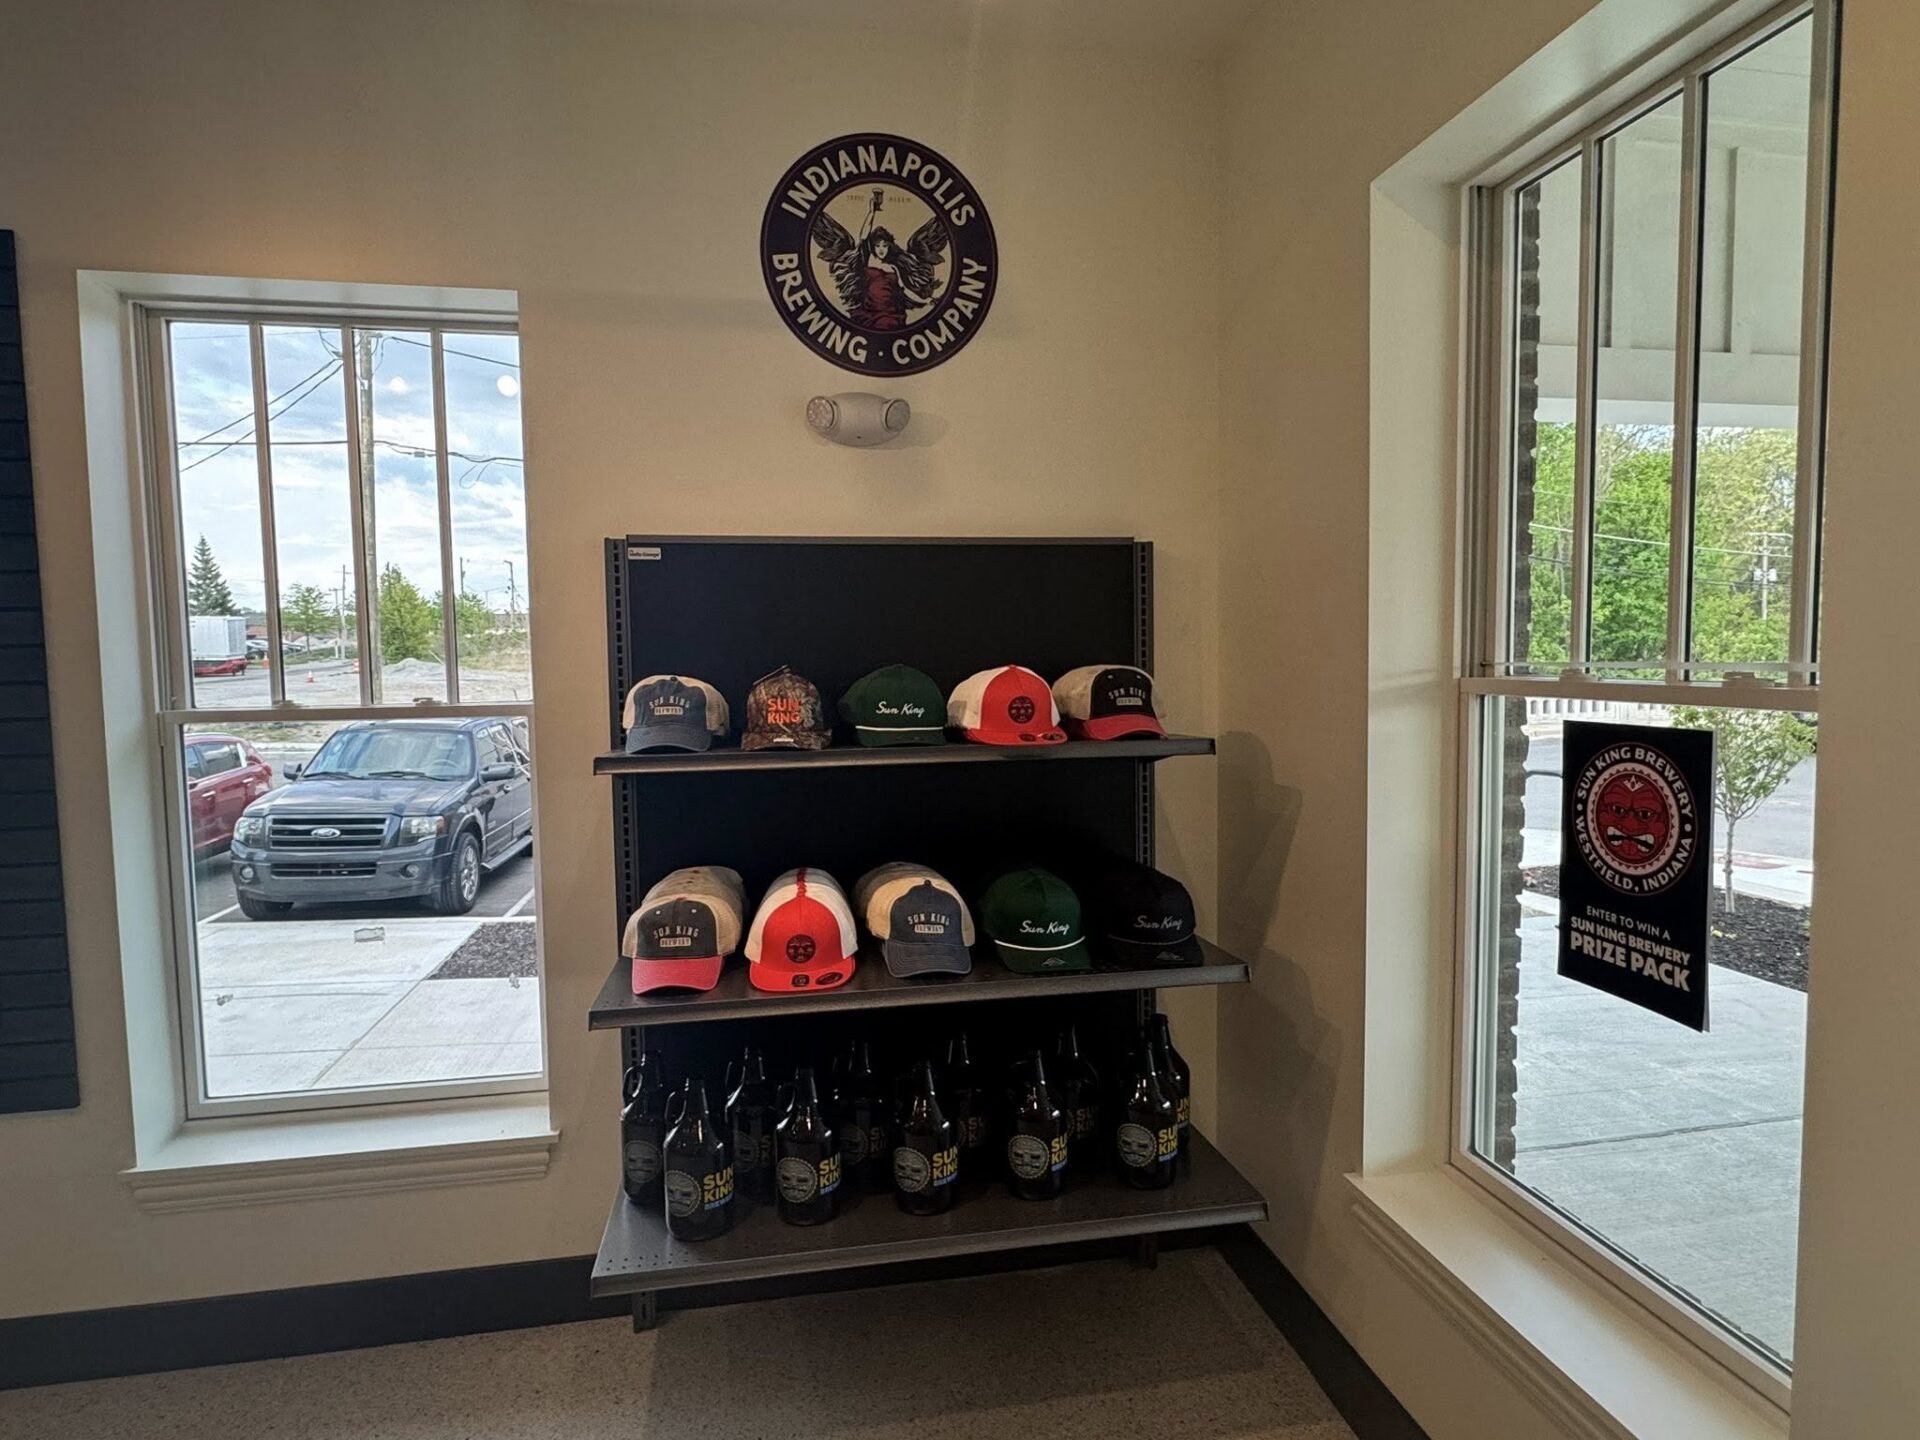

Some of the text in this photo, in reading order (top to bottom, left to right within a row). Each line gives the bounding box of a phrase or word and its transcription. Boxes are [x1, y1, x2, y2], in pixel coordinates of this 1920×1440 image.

[781, 144, 976, 227] INDIANAPOLIS
[772, 253, 988, 365] BREWING COMPANY
[767, 698, 800, 711] SUN
[875, 700, 925, 718] Sun King
[767, 711, 801, 725] KING
[1577, 747, 1694, 818] SUN KING BREWERY
[1576, 815, 1693, 893] WESTFIELD, INDIANA
[1019, 919, 1070, 936] Sun King
[1134, 914, 1183, 931] Sun King
[1586, 905, 1671, 941] ENTER TO WIN A
[1570, 915, 1691, 966] SUN KING BREWERY
[1570, 930, 1691, 993] PRIZE PACK
[1051, 1132, 1068, 1152] SU
[1158, 1138, 1179, 1156] KIN
[1051, 1145, 1068, 1165] KIN
[703, 1161, 735, 1190] SUN
[818, 1167, 842, 1188] KIN
